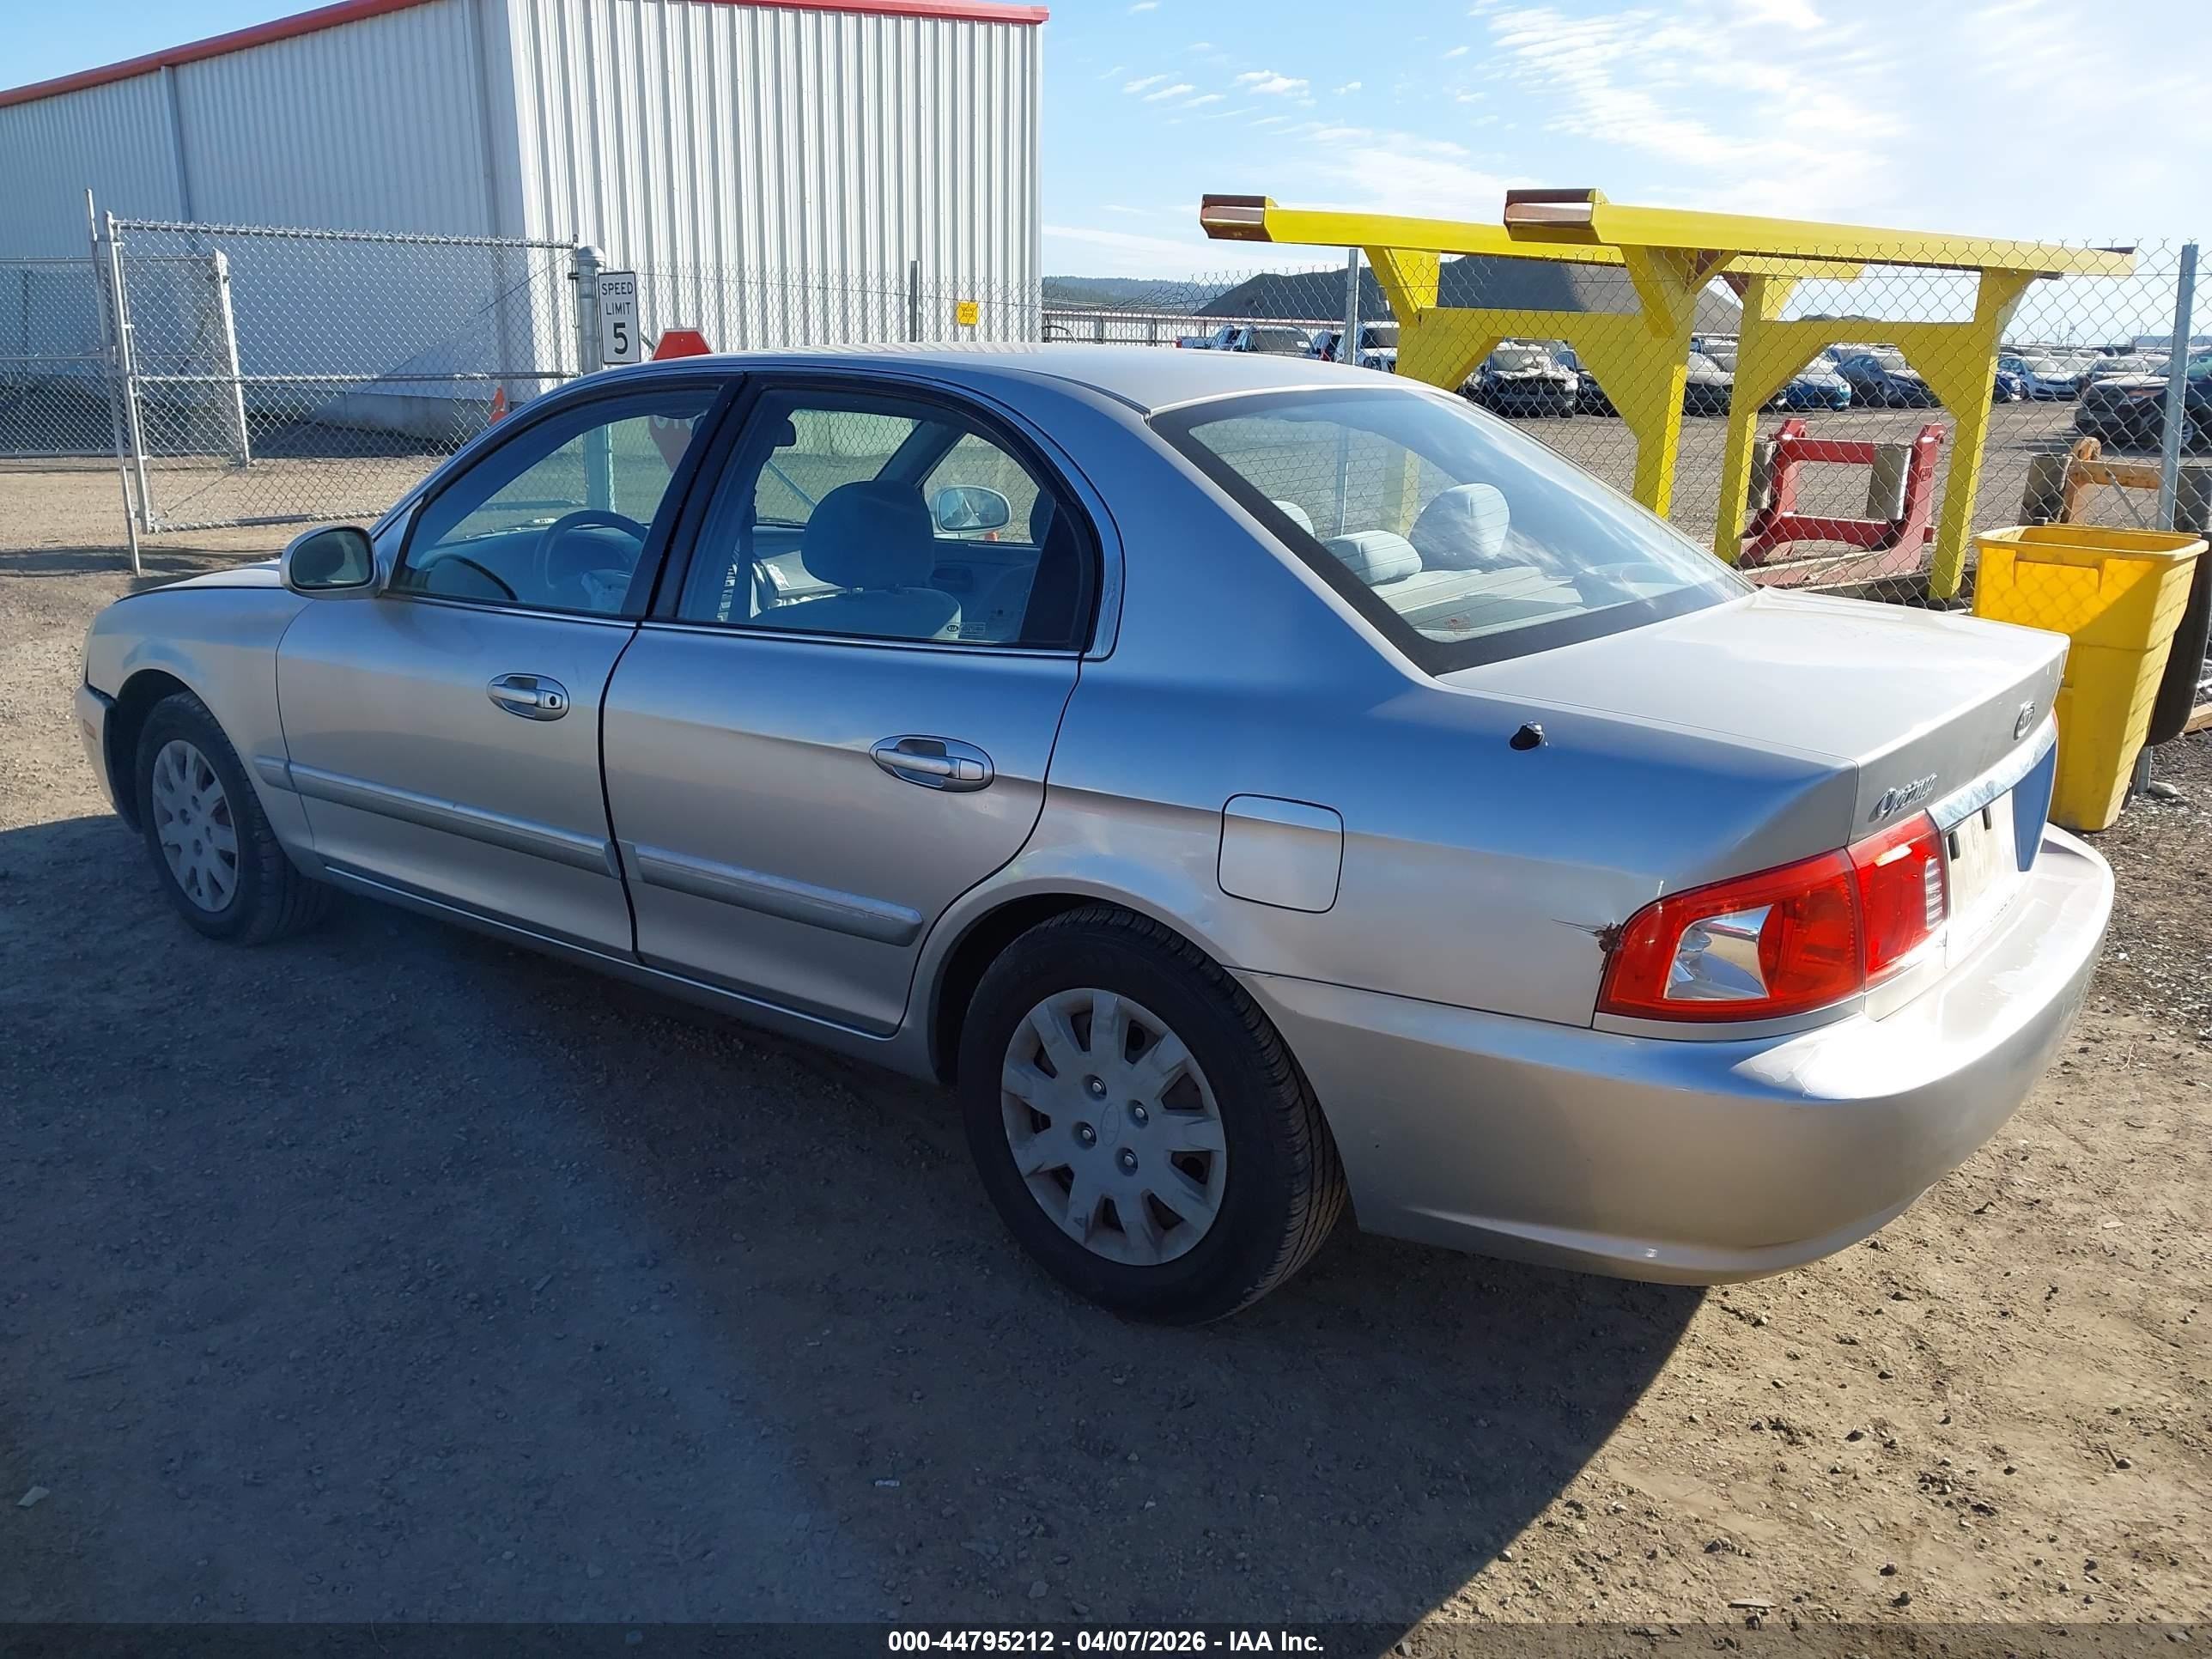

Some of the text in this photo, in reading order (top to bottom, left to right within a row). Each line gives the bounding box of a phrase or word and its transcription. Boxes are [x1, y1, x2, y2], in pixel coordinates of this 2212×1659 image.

[601, 282, 634, 295] SPEED
[605, 302, 631, 315] LIMIT
[613, 322, 629, 355] 5
